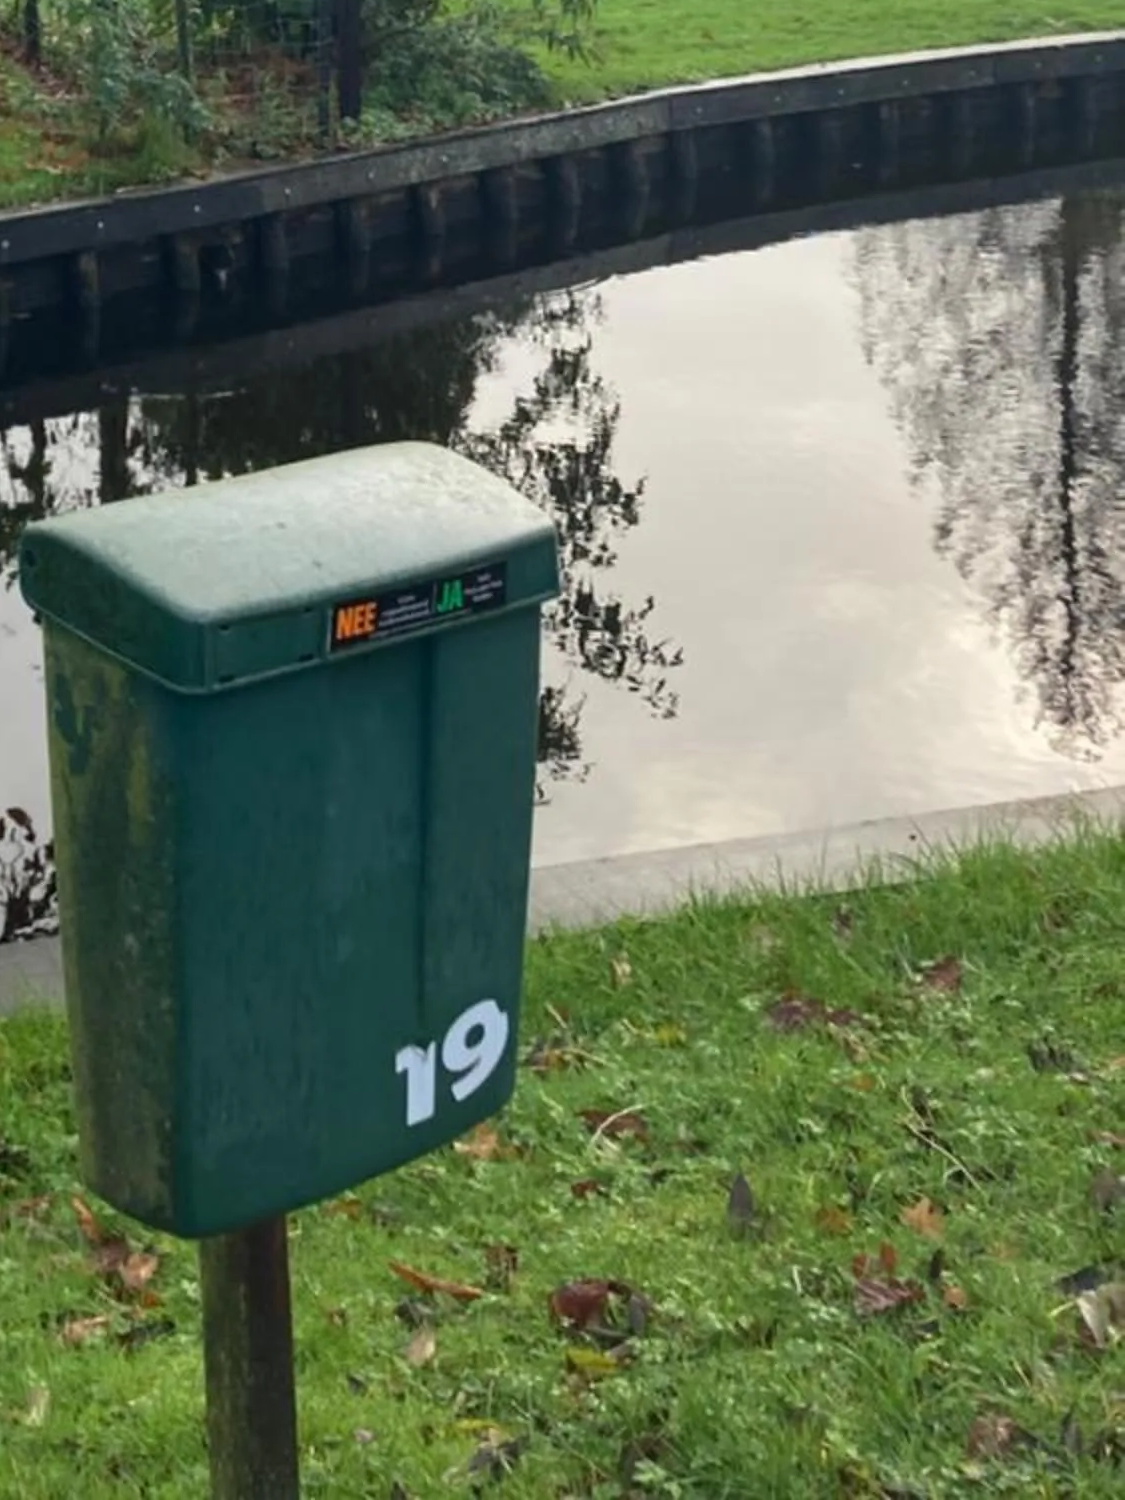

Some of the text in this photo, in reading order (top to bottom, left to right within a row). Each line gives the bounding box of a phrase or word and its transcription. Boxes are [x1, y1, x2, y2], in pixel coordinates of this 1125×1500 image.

[336, 602, 377, 640] NEE
[437, 579, 463, 613] JA
[395, 999, 509, 1127] 19
